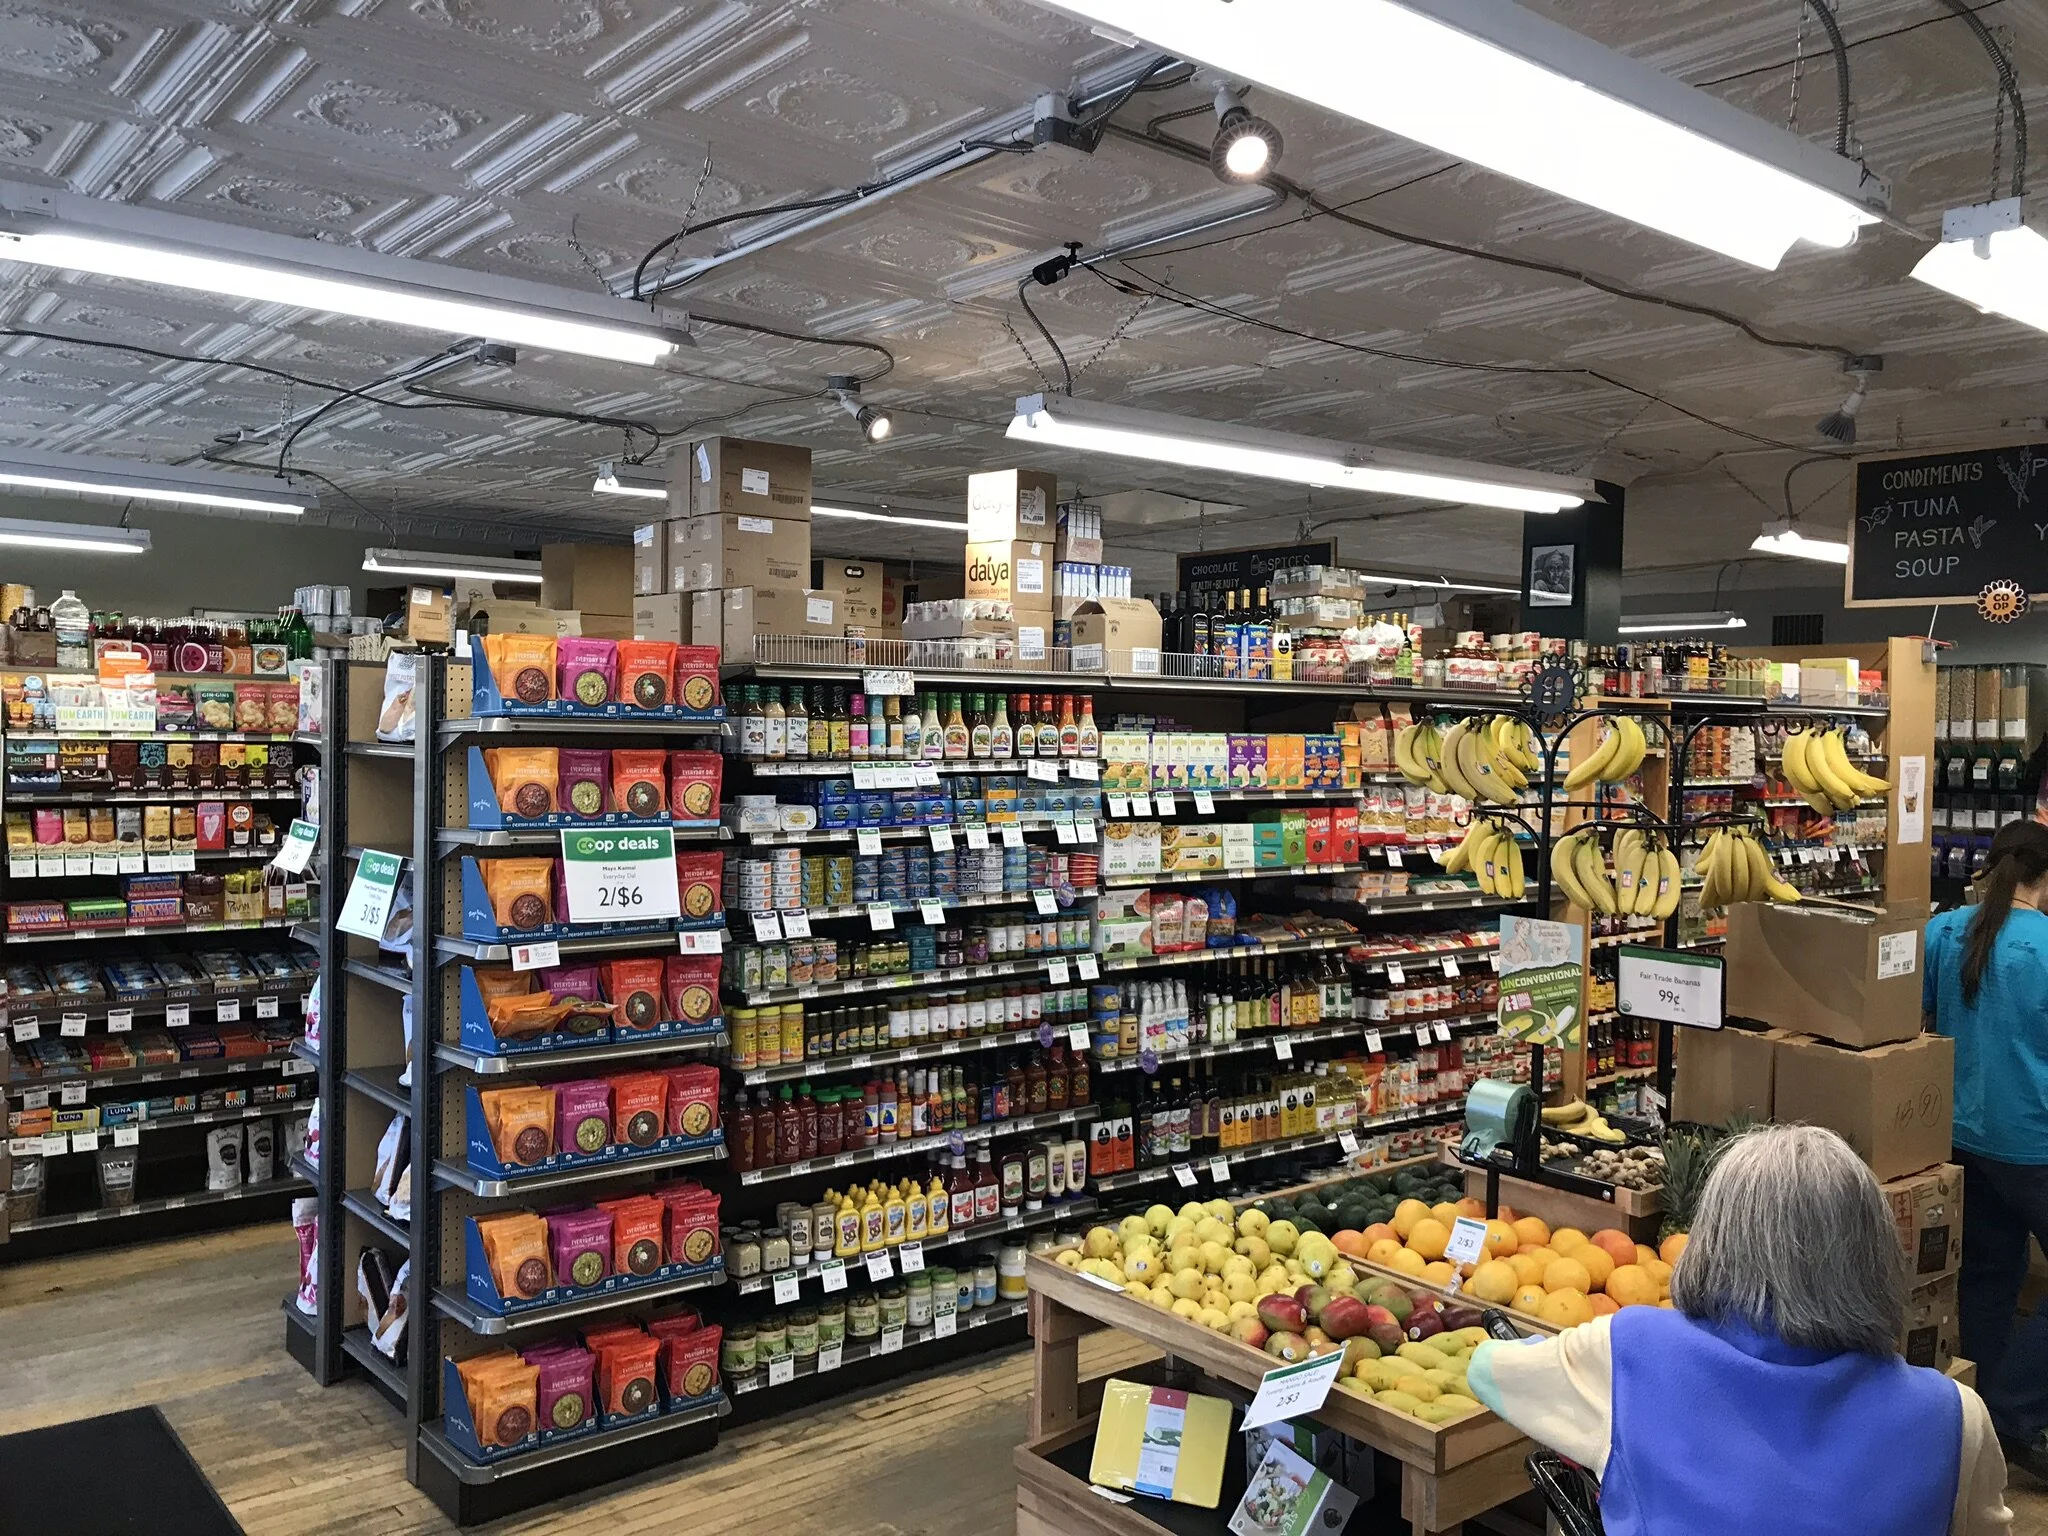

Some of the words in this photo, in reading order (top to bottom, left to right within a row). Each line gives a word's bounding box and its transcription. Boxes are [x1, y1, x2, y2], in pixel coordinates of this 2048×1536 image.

[1882, 462, 1984, 491] CONDIMENTS
[1897, 495, 1961, 518] TUNA
[1894, 525, 1966, 549] PASTA
[968, 556, 1009, 586] daiya
[1191, 561, 1239, 576] CHOCOLATE
[1894, 556, 1961, 579] SOUP
[1992, 592, 2010, 603] CO
[1992, 602, 2010, 612] OP
[153, 649, 168, 657] IZZE
[10, 756, 31, 764] MILK
[62, 756, 82, 764] DARK
[1283, 818, 1306, 830] POW!
[1305, 816, 1330, 829] POW!
[1336, 815, 1358, 829] POW!
[618, 836, 660, 850] deals
[380, 861, 396, 877] deals
[598, 885, 644, 908] 2/$6
[360, 903, 381, 926] 3/$5
[1500, 967, 1582, 990] UNCONVENTIONAL
[1639, 971, 1652, 980] Fair
[1653, 973, 1673, 984] Trade
[1674, 976, 1701, 987] Bananas
[1658, 989, 1680, 1005] 99¢
[275, 1091, 297, 1100] KIND
[174, 1103, 196, 1113] KIND
[225, 1099, 247, 1108] KIND
[109, 1107, 132, 1115] LUNA
[1457, 1236, 1474, 1248] 2/$3
